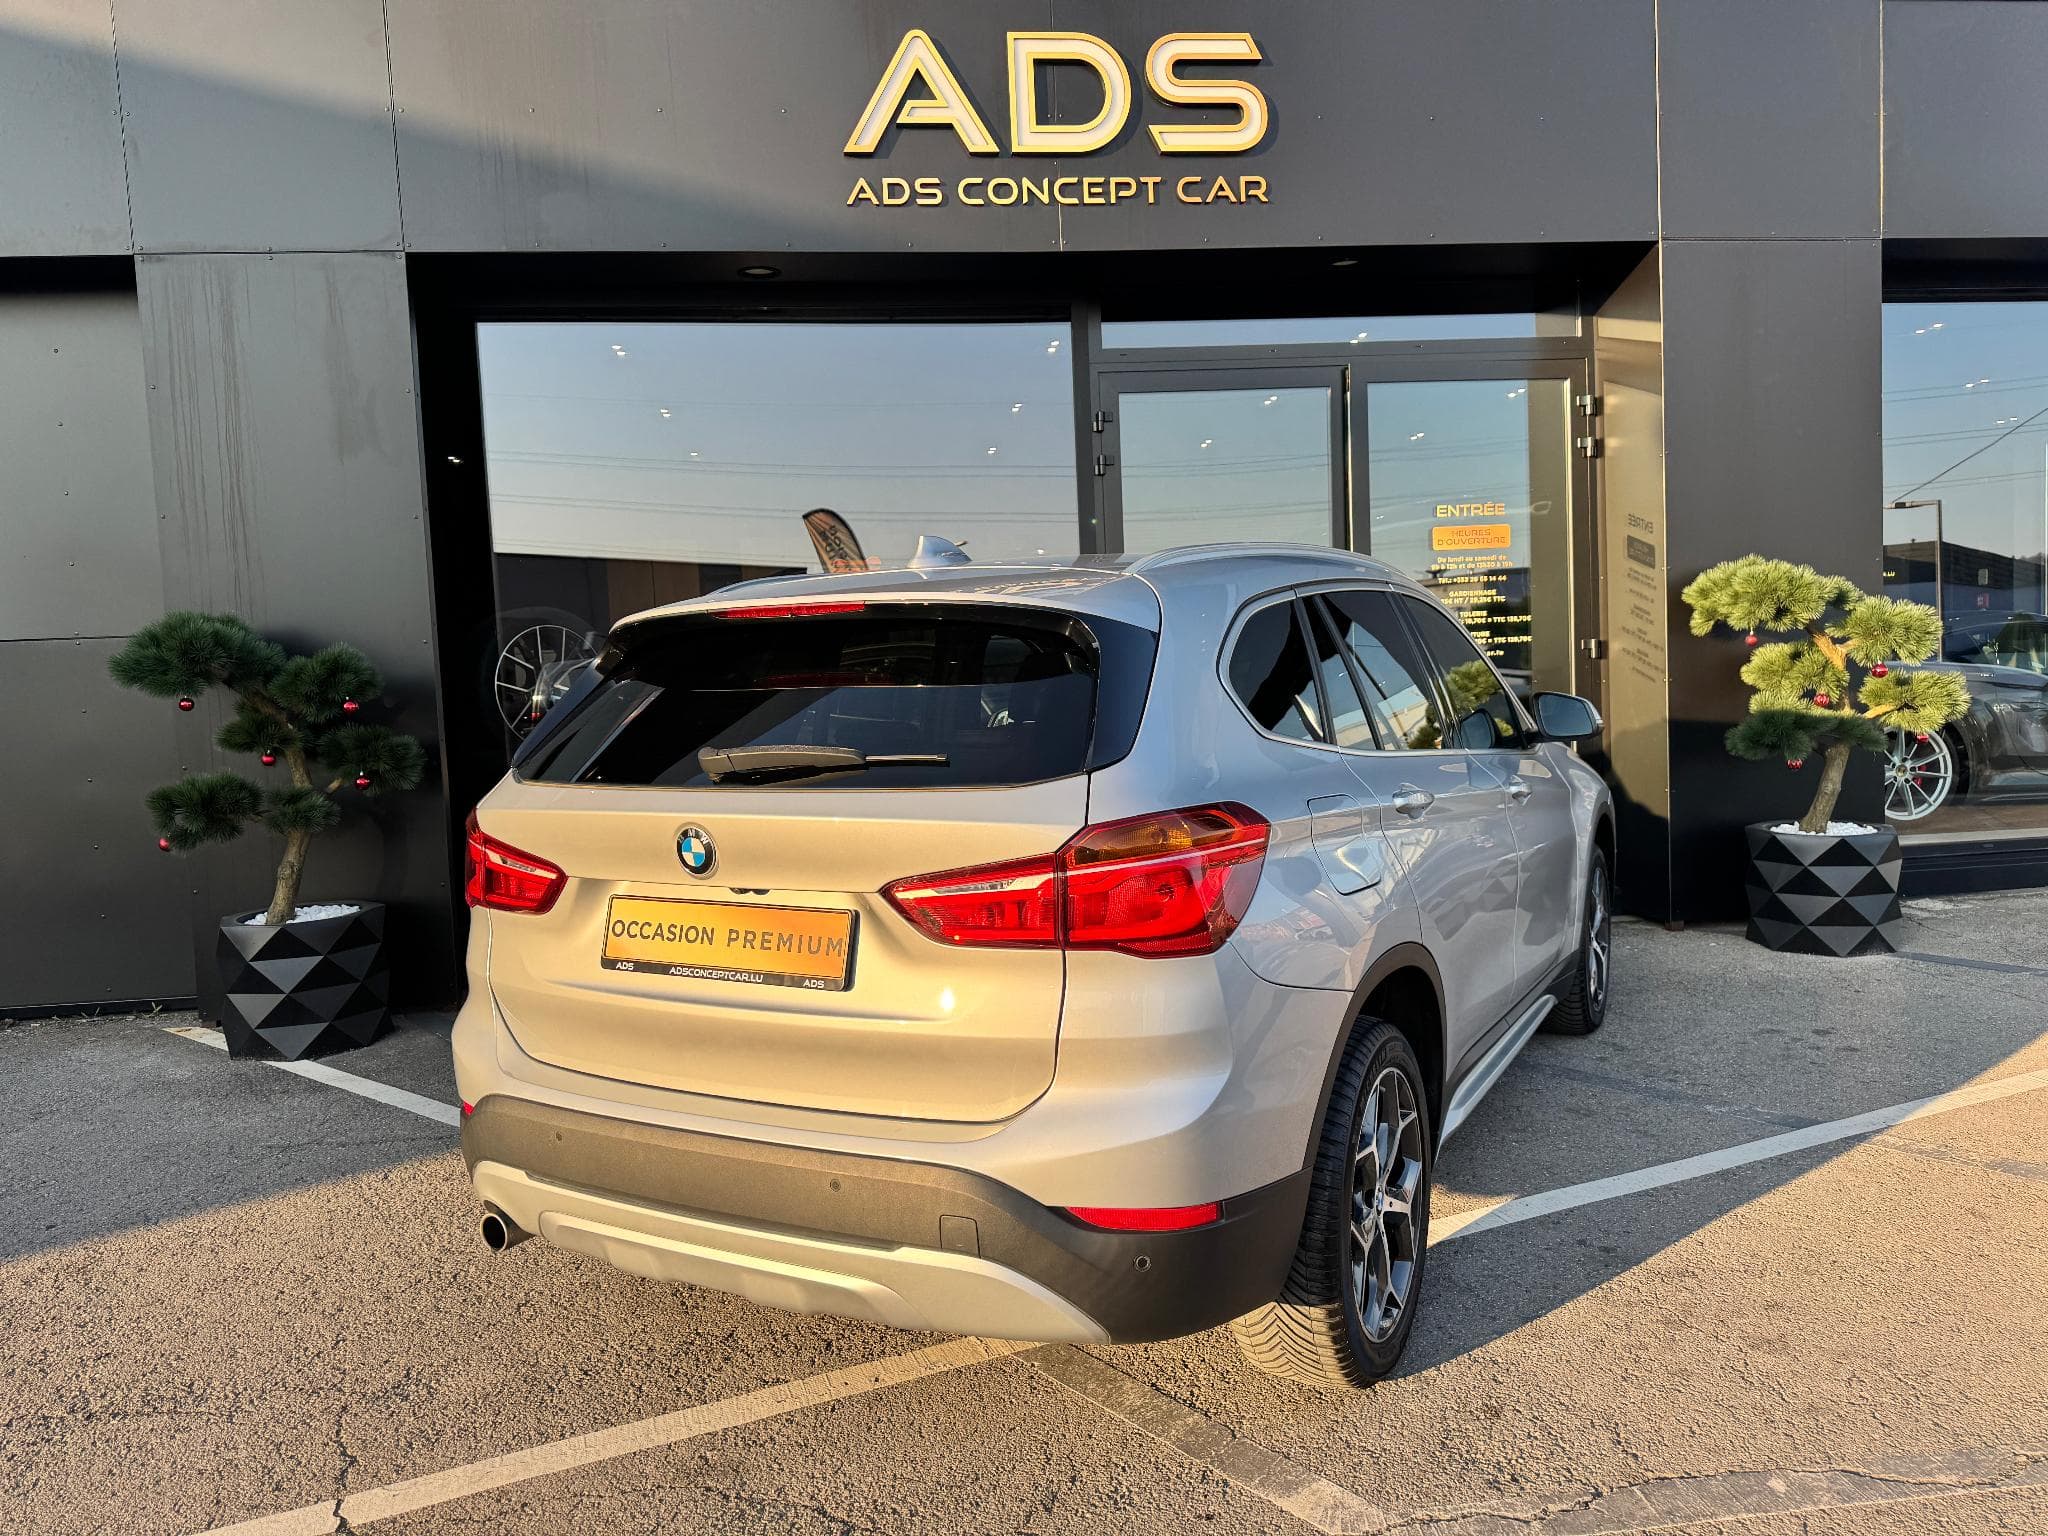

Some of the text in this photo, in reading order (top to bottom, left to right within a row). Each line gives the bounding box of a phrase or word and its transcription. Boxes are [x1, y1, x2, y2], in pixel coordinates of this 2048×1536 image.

[843, 28, 1269, 154] ADS
[847, 175, 1269, 205] ADS CONCEPT CAR
[1436, 501, 1505, 518] ENTRÉE
[1438, 536, 1506, 546] D'OUVERTURE
[1450, 529, 1491, 538] HEURES
[611, 919, 844, 957] OCCASION PREMIUM
[615, 961, 824, 989] ADS ADSCONCEPTCAR.LU ADS
